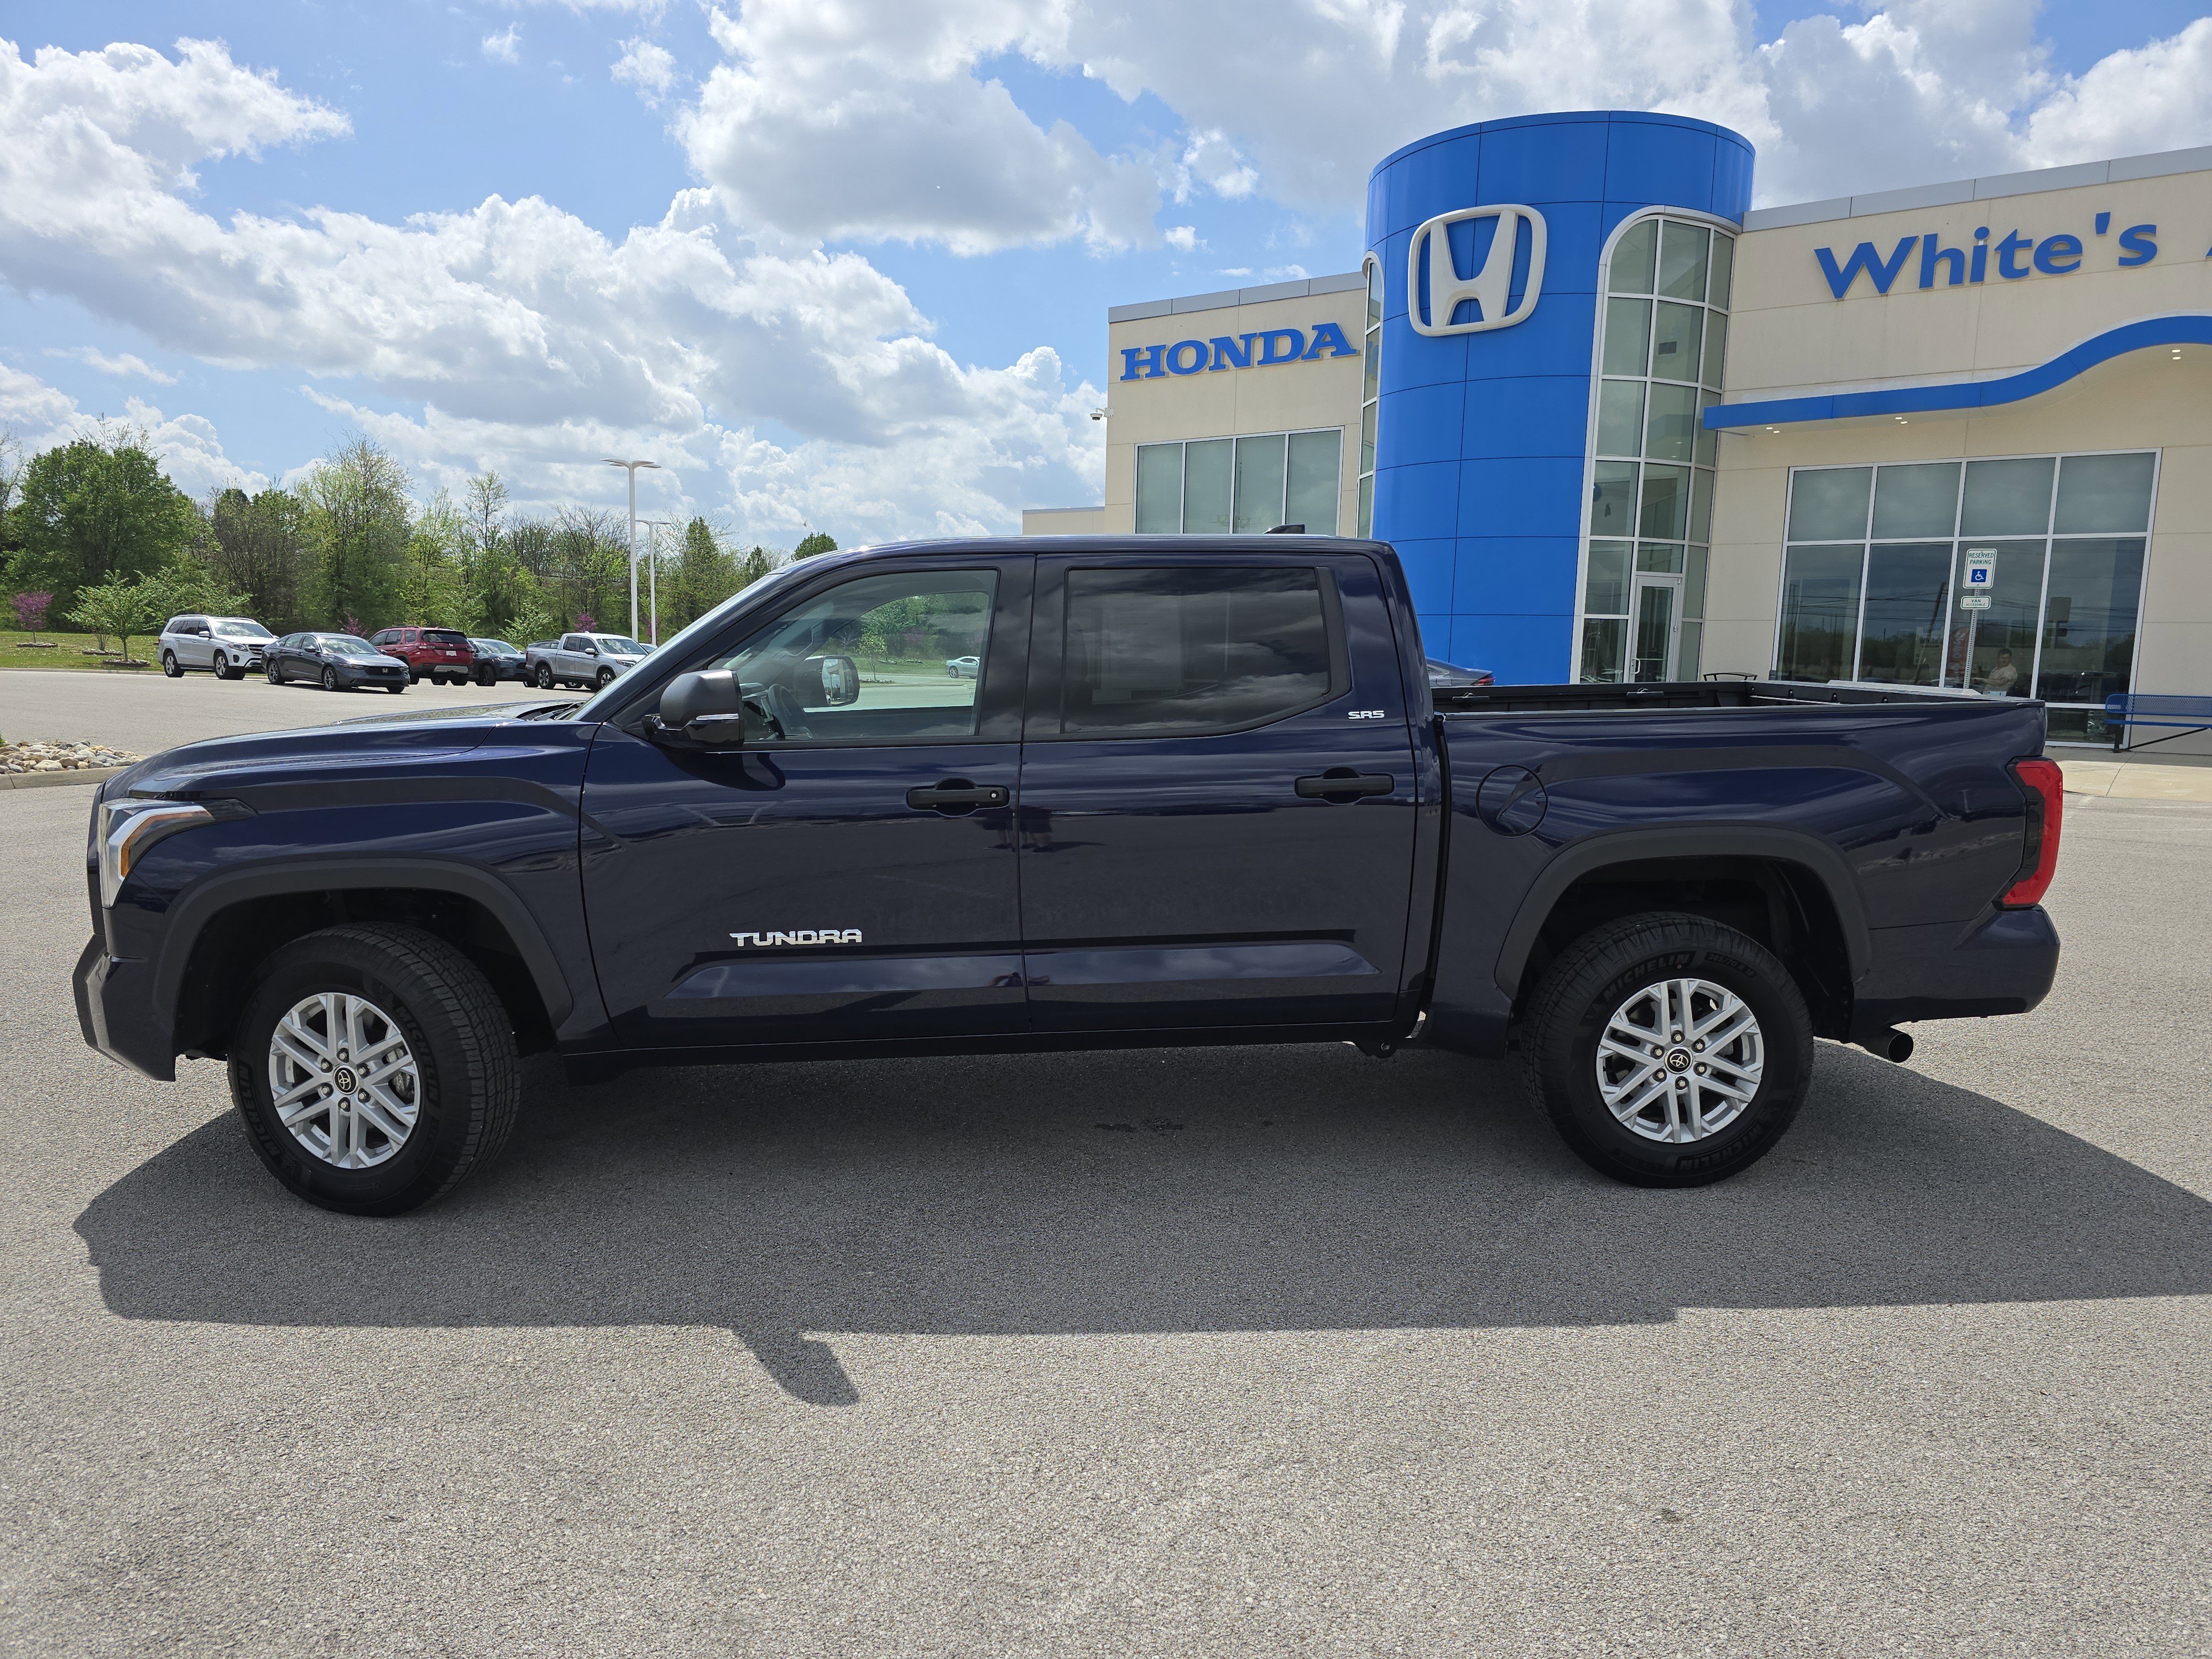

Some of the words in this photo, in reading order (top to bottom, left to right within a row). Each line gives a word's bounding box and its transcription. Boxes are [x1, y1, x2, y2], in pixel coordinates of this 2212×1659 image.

[1814, 211, 2158, 300] White's
[1120, 322, 1358, 382] HONDA
[1348, 710, 1385, 719] SR5
[729, 929, 862, 947] TUNDRA
[1604, 953, 1690, 1001] MICHELIN
[395, 1004, 440, 1104] MICHELIN
[238, 1065, 278, 1157] MICHELIN
[1679, 1121, 1764, 1171] MICHELIN
